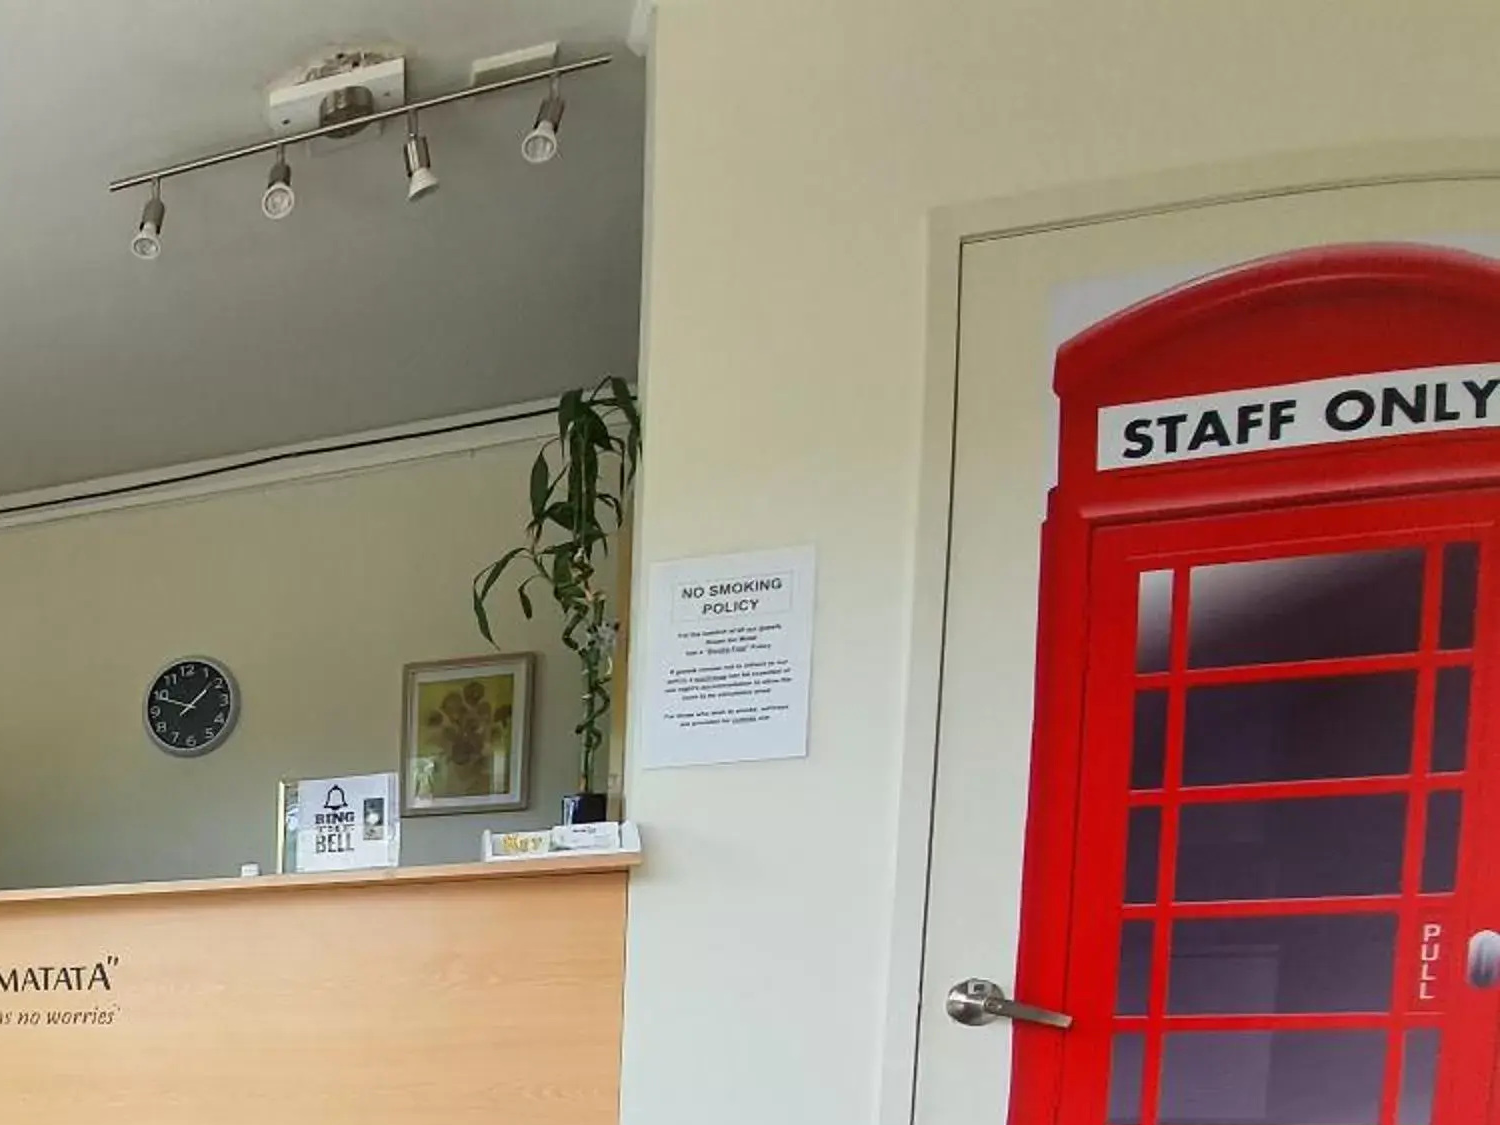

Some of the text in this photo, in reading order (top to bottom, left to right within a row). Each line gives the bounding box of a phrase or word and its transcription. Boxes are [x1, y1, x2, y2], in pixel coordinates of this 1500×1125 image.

[1121, 379, 1500, 460] STAFF ONLY
[682, 577, 783, 599] NO SMOKING
[702, 599, 759, 615] POLICY
[180, 664, 195, 676] 12
[203, 667, 210, 678] 1
[164, 673, 177, 685] 11
[214, 677, 223, 689] 2
[153, 689, 169, 701] 10
[220, 694, 229, 707] 3
[150, 706, 161, 718] 9
[214, 712, 224, 723] 4
[156, 722, 167, 732] 8
[205, 727, 214, 739] 5
[171, 731, 180, 743] 7
[186, 735, 197, 747] 6
[316, 832, 355, 854] BELL
[1419, 923, 1442, 1000] PULL
[17, 1011, 40, 1026] no
